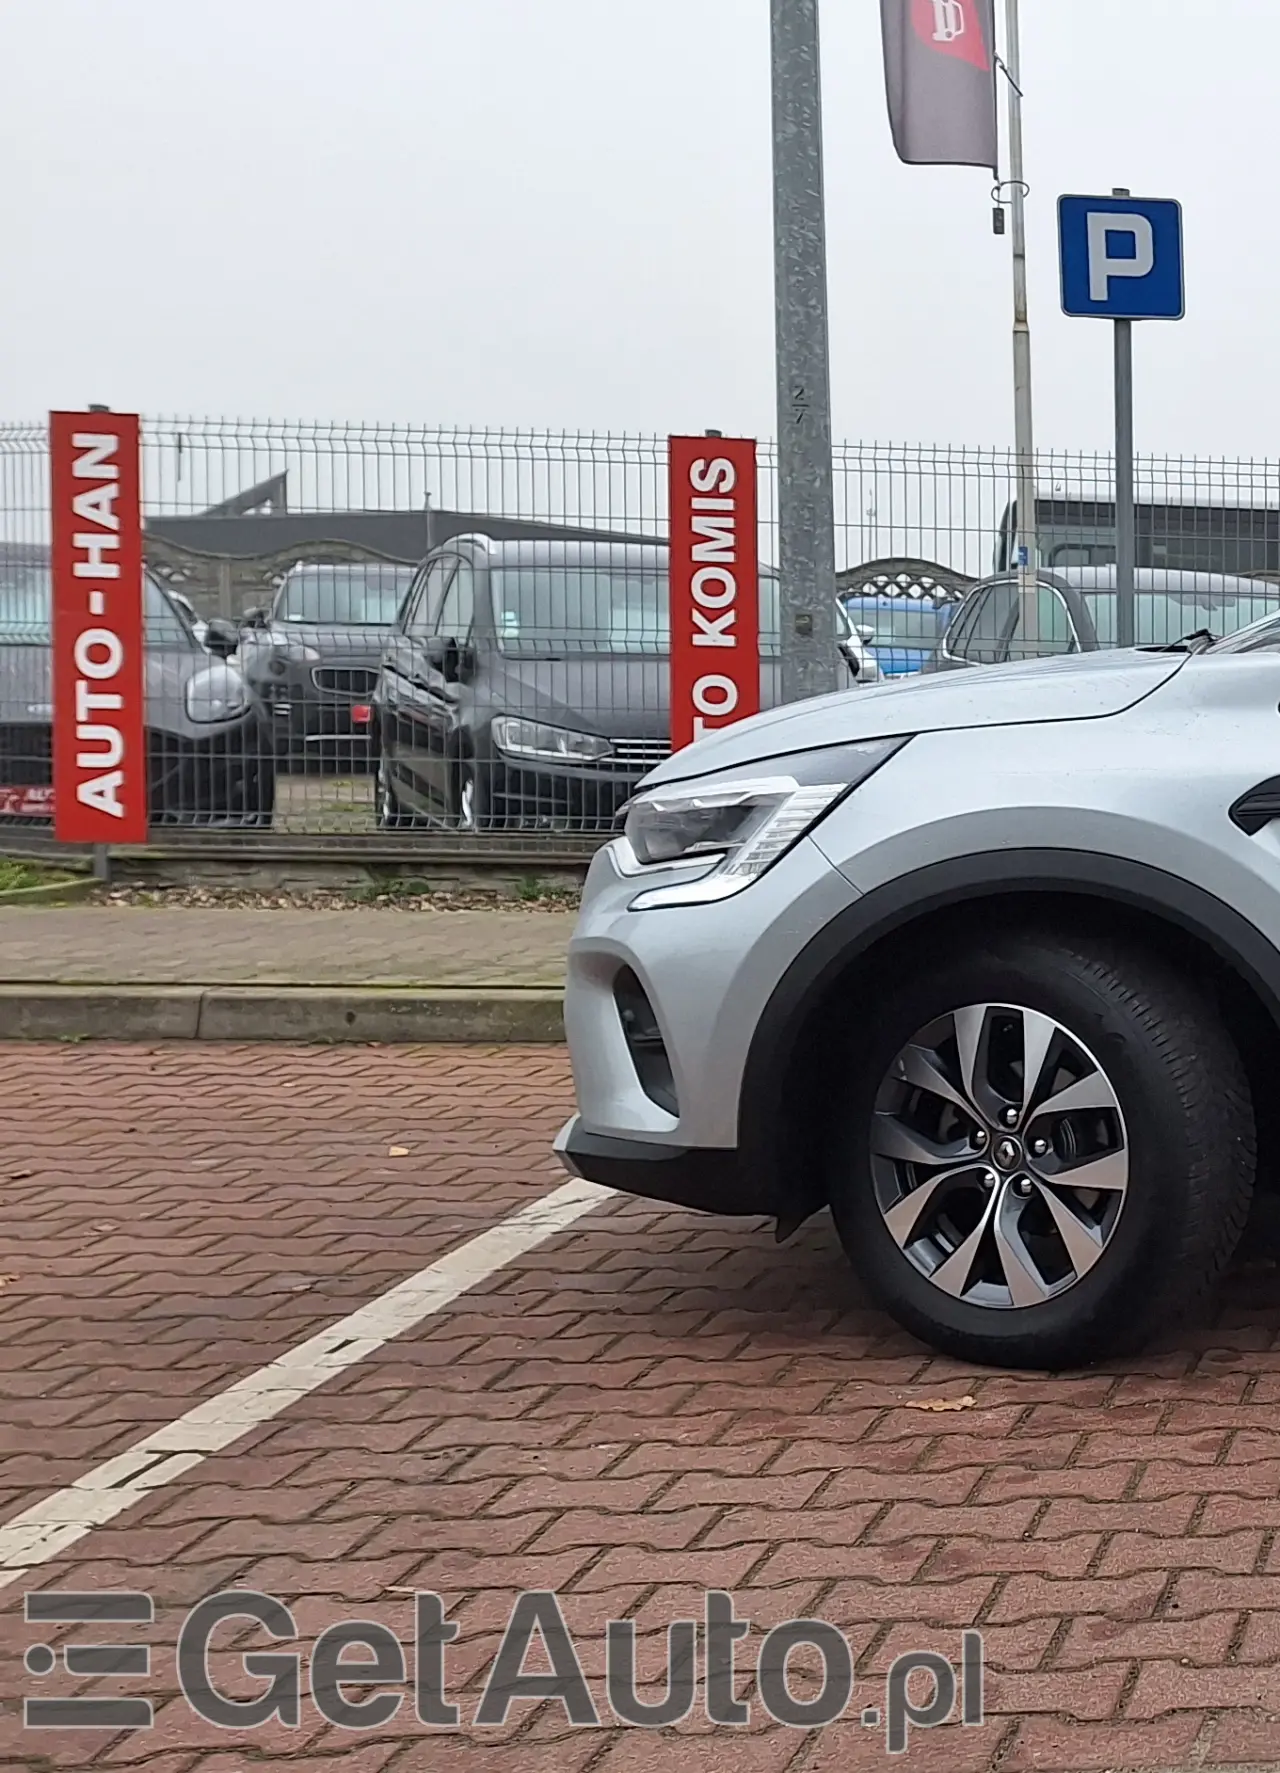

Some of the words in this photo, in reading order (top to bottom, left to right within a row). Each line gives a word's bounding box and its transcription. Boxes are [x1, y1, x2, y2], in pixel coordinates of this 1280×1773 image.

[1087, 211, 1154, 301] P
[72, 432, 126, 818] AUTO-HAN
[689, 457, 736, 647] KOMIS
